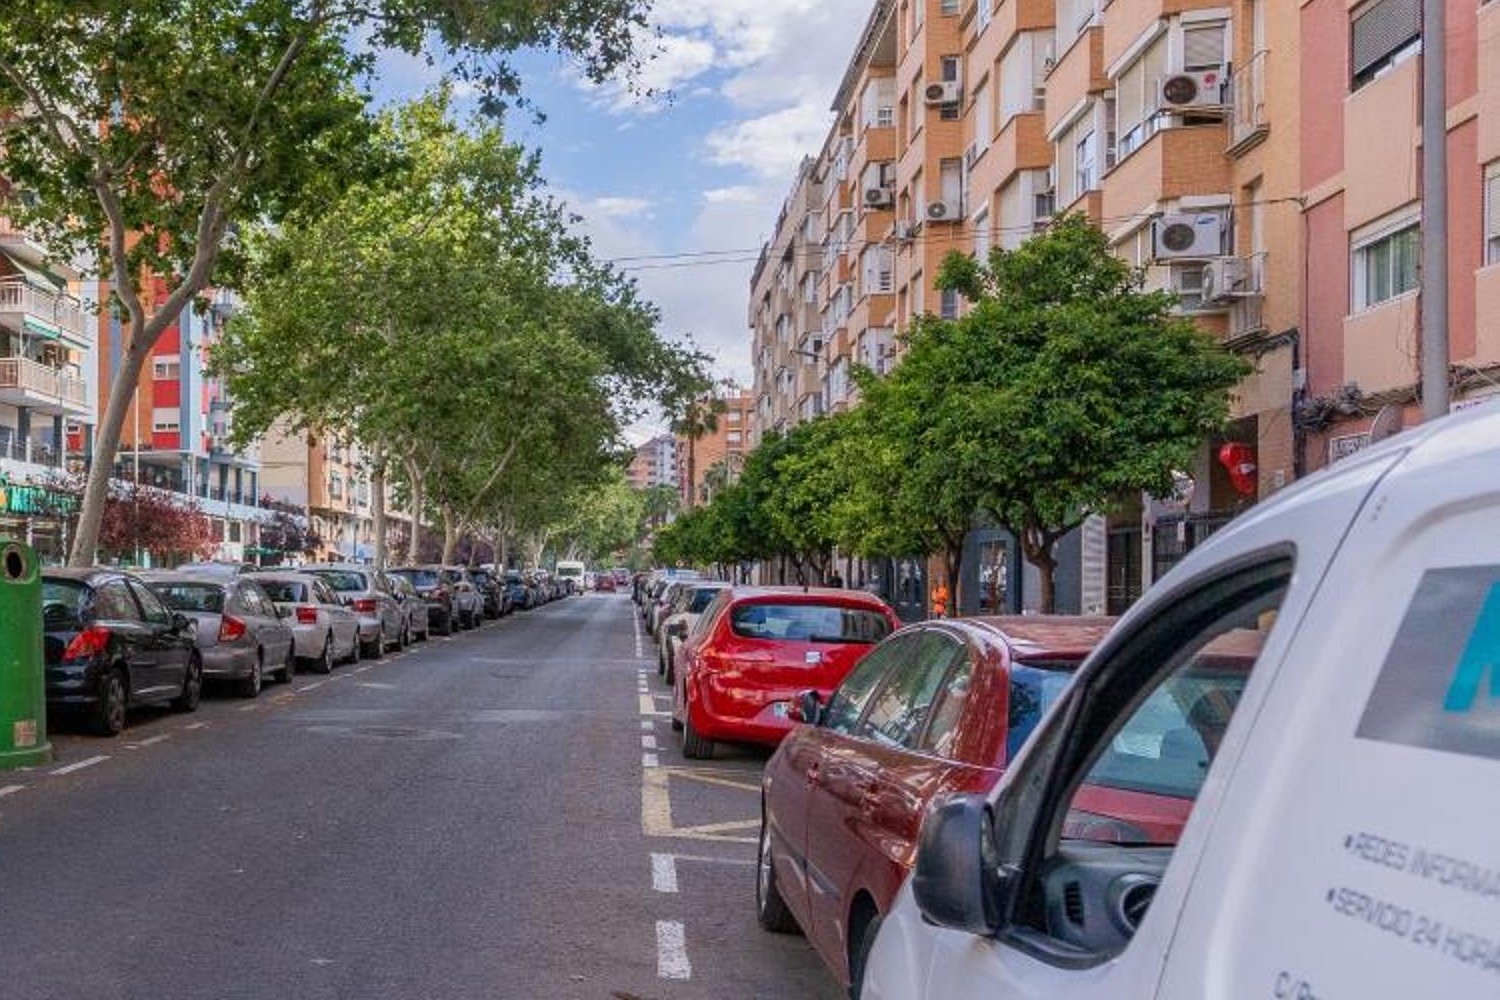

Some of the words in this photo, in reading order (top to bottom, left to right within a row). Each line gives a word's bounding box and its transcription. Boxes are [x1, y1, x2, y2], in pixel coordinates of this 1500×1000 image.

[1353, 832, 1409, 871] REDES
[1334, 887, 1412, 937] SERVICIO
[1411, 915, 1442, 945] 24
